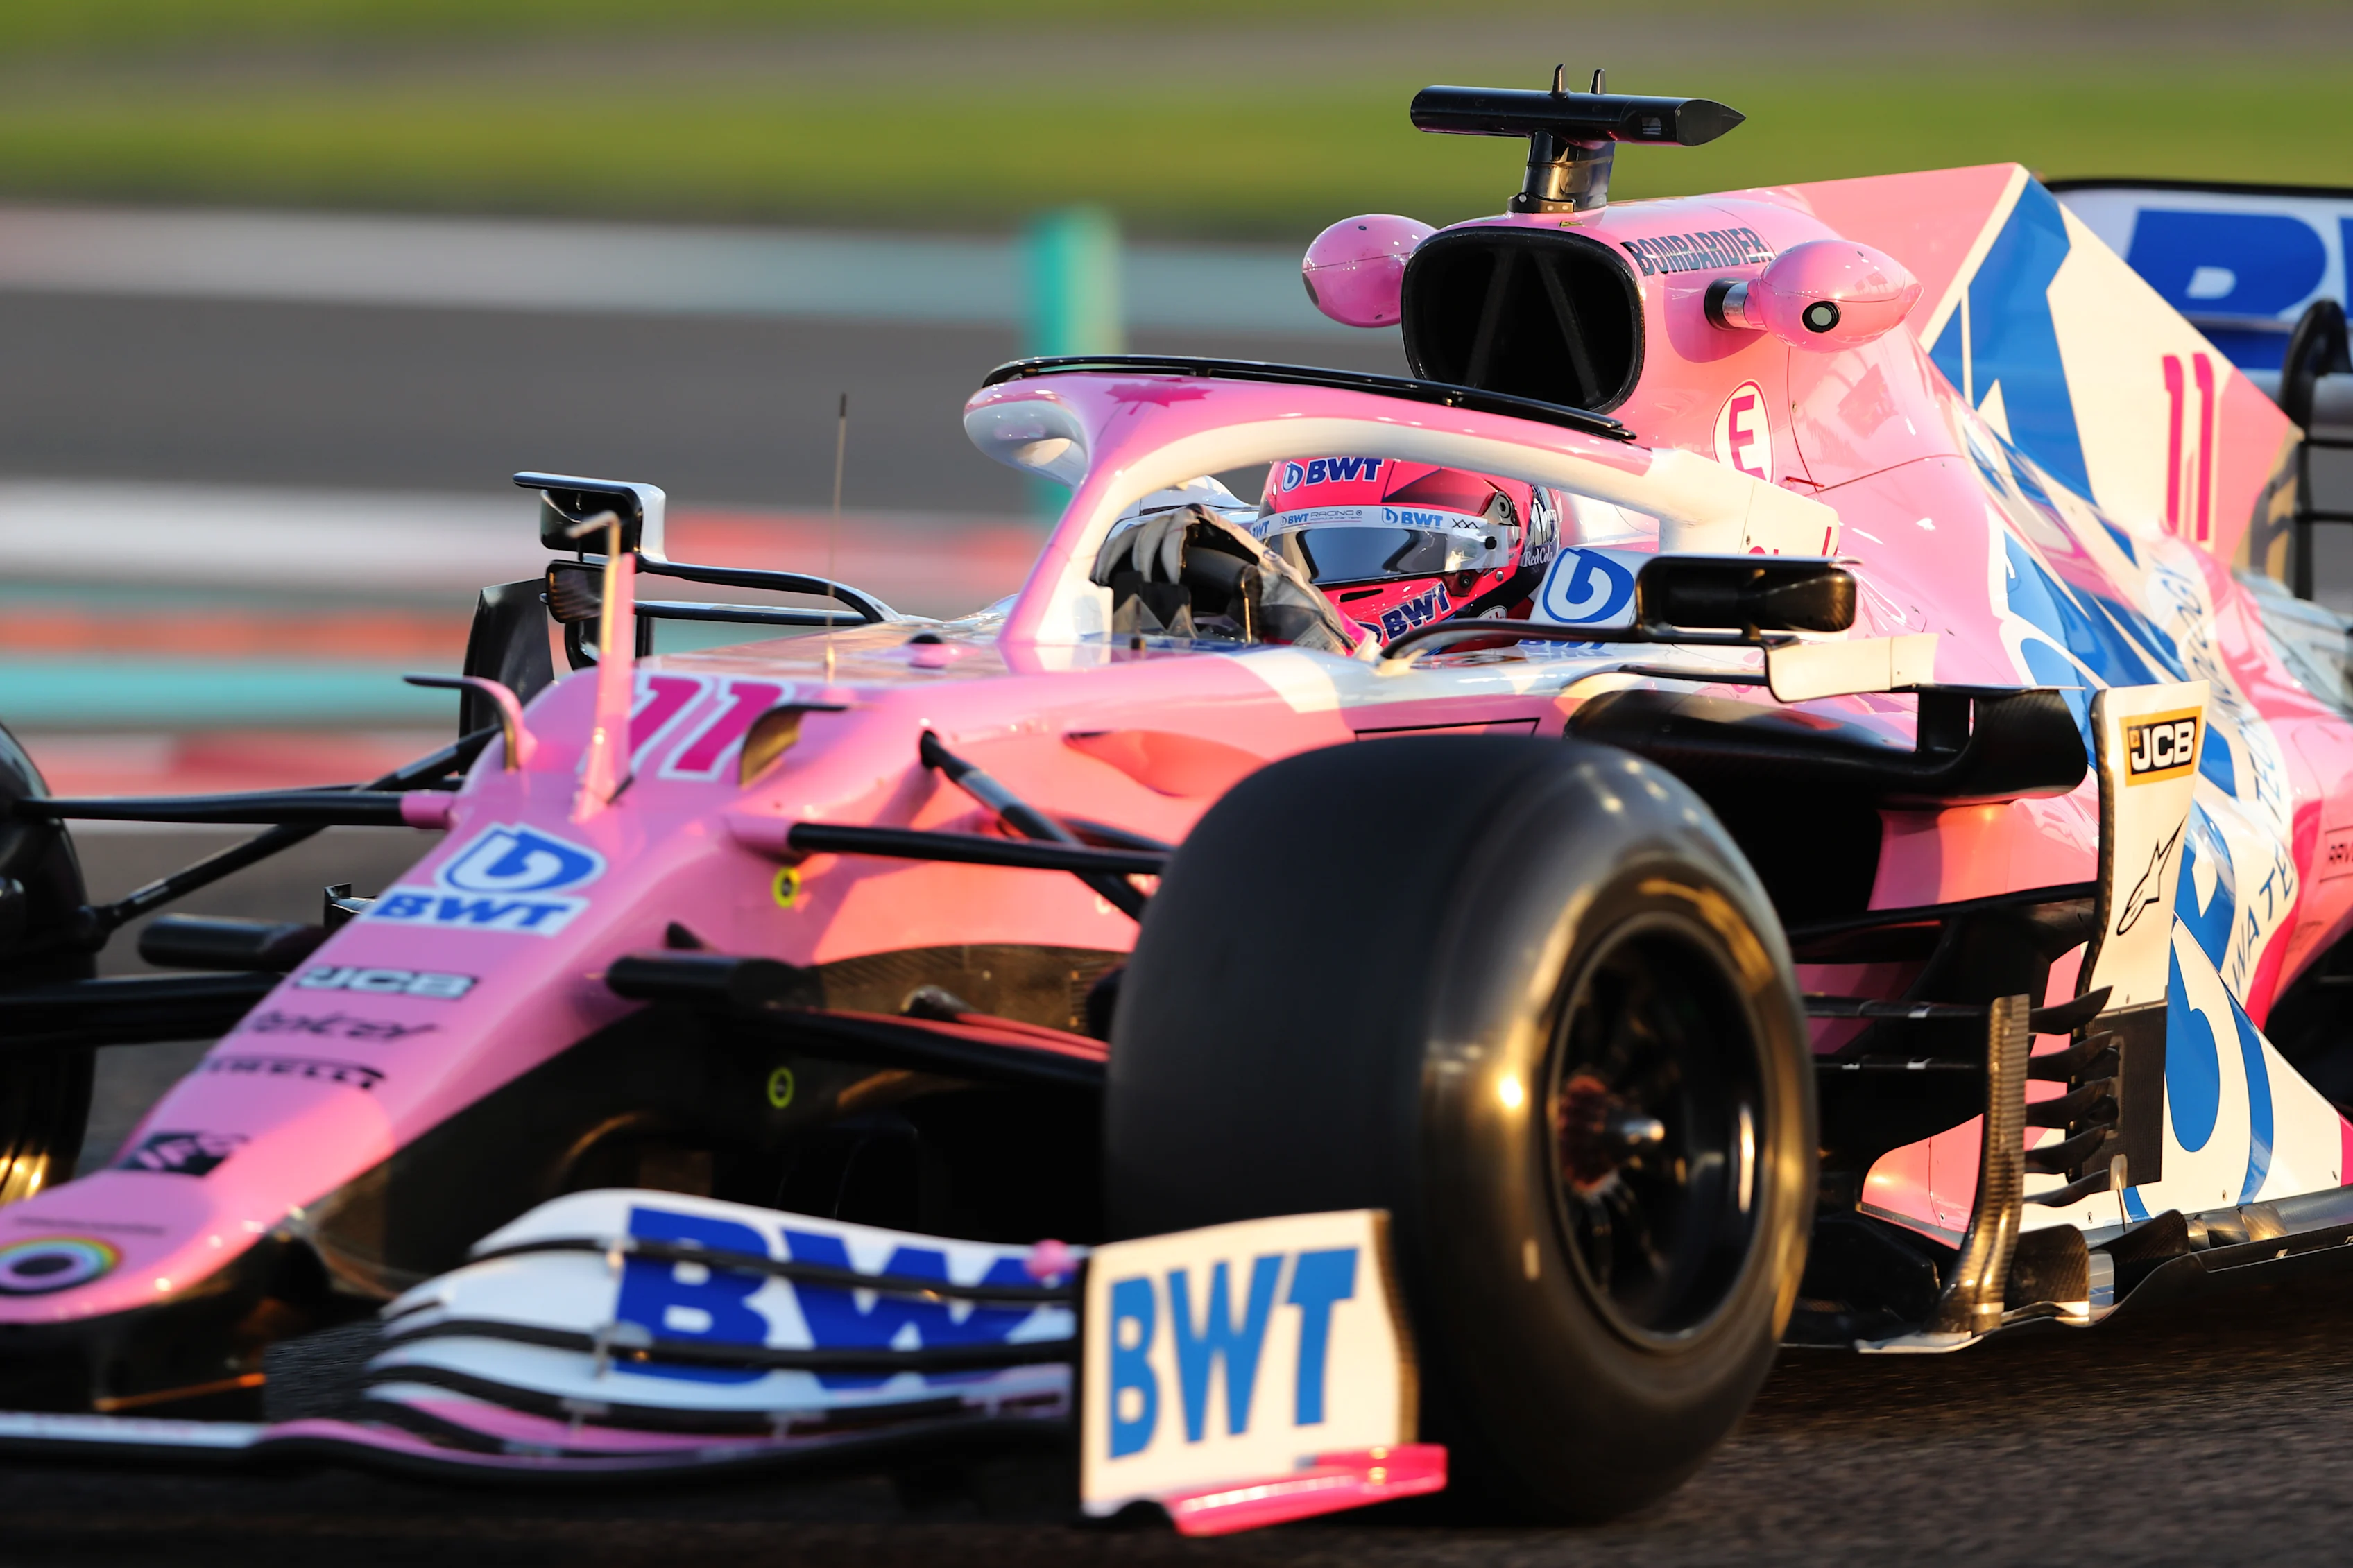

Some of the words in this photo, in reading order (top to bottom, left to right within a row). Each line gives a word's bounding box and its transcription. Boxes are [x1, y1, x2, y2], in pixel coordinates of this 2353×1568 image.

[1620, 227, 1773, 276] BOMBARDIER
[1305, 456, 1384, 486] BWT
[1288, 513, 1309, 524] BWT
[1401, 512, 1444, 529] BWT
[1380, 583, 1450, 640] BWT
[2130, 721, 2196, 771] JCB
[373, 893, 574, 929] BWT
[1108, 1246, 1360, 1459] BWT
